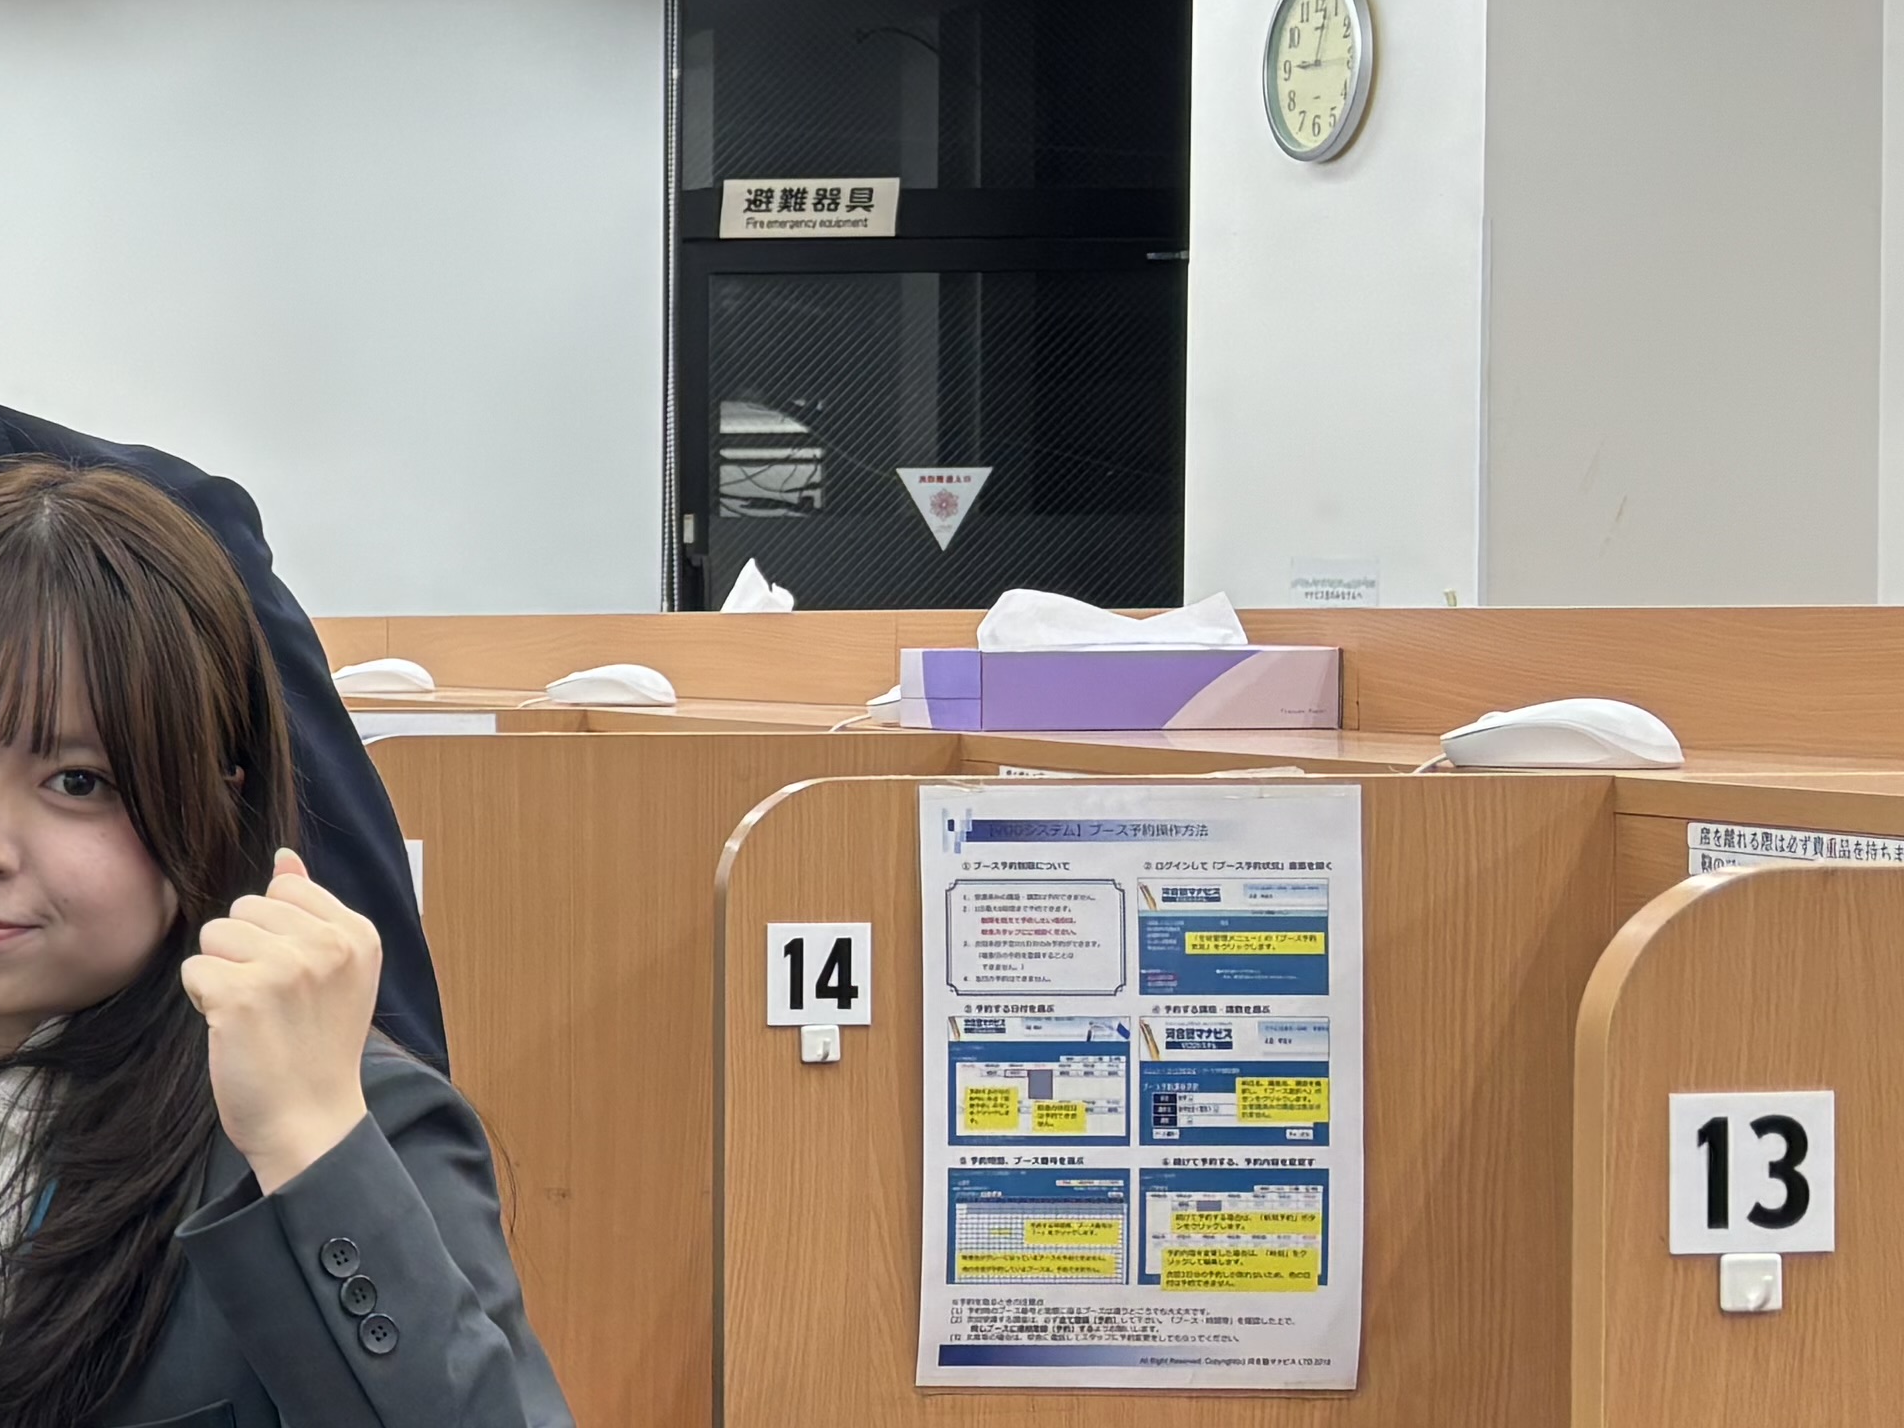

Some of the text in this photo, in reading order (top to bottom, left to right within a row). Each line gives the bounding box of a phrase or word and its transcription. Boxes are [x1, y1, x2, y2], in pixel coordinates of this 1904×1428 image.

[1299, 1, 1310, 23] 11
[1288, 26, 1301, 49] 10
[1342, 16, 1351, 39] 2
[1283, 60, 1291, 81] 9
[1287, 90, 1296, 112] 8
[1298, 110, 1307, 133] 7
[1311, 115, 1321, 137] 6
[1329, 106, 1337, 128] 5
[743, 187, 875, 213] 避難器具
[745, 217, 868, 231] Fire emergency equipment
[783, 937, 859, 1010] 14
[1696, 1114, 1811, 1231] 13
